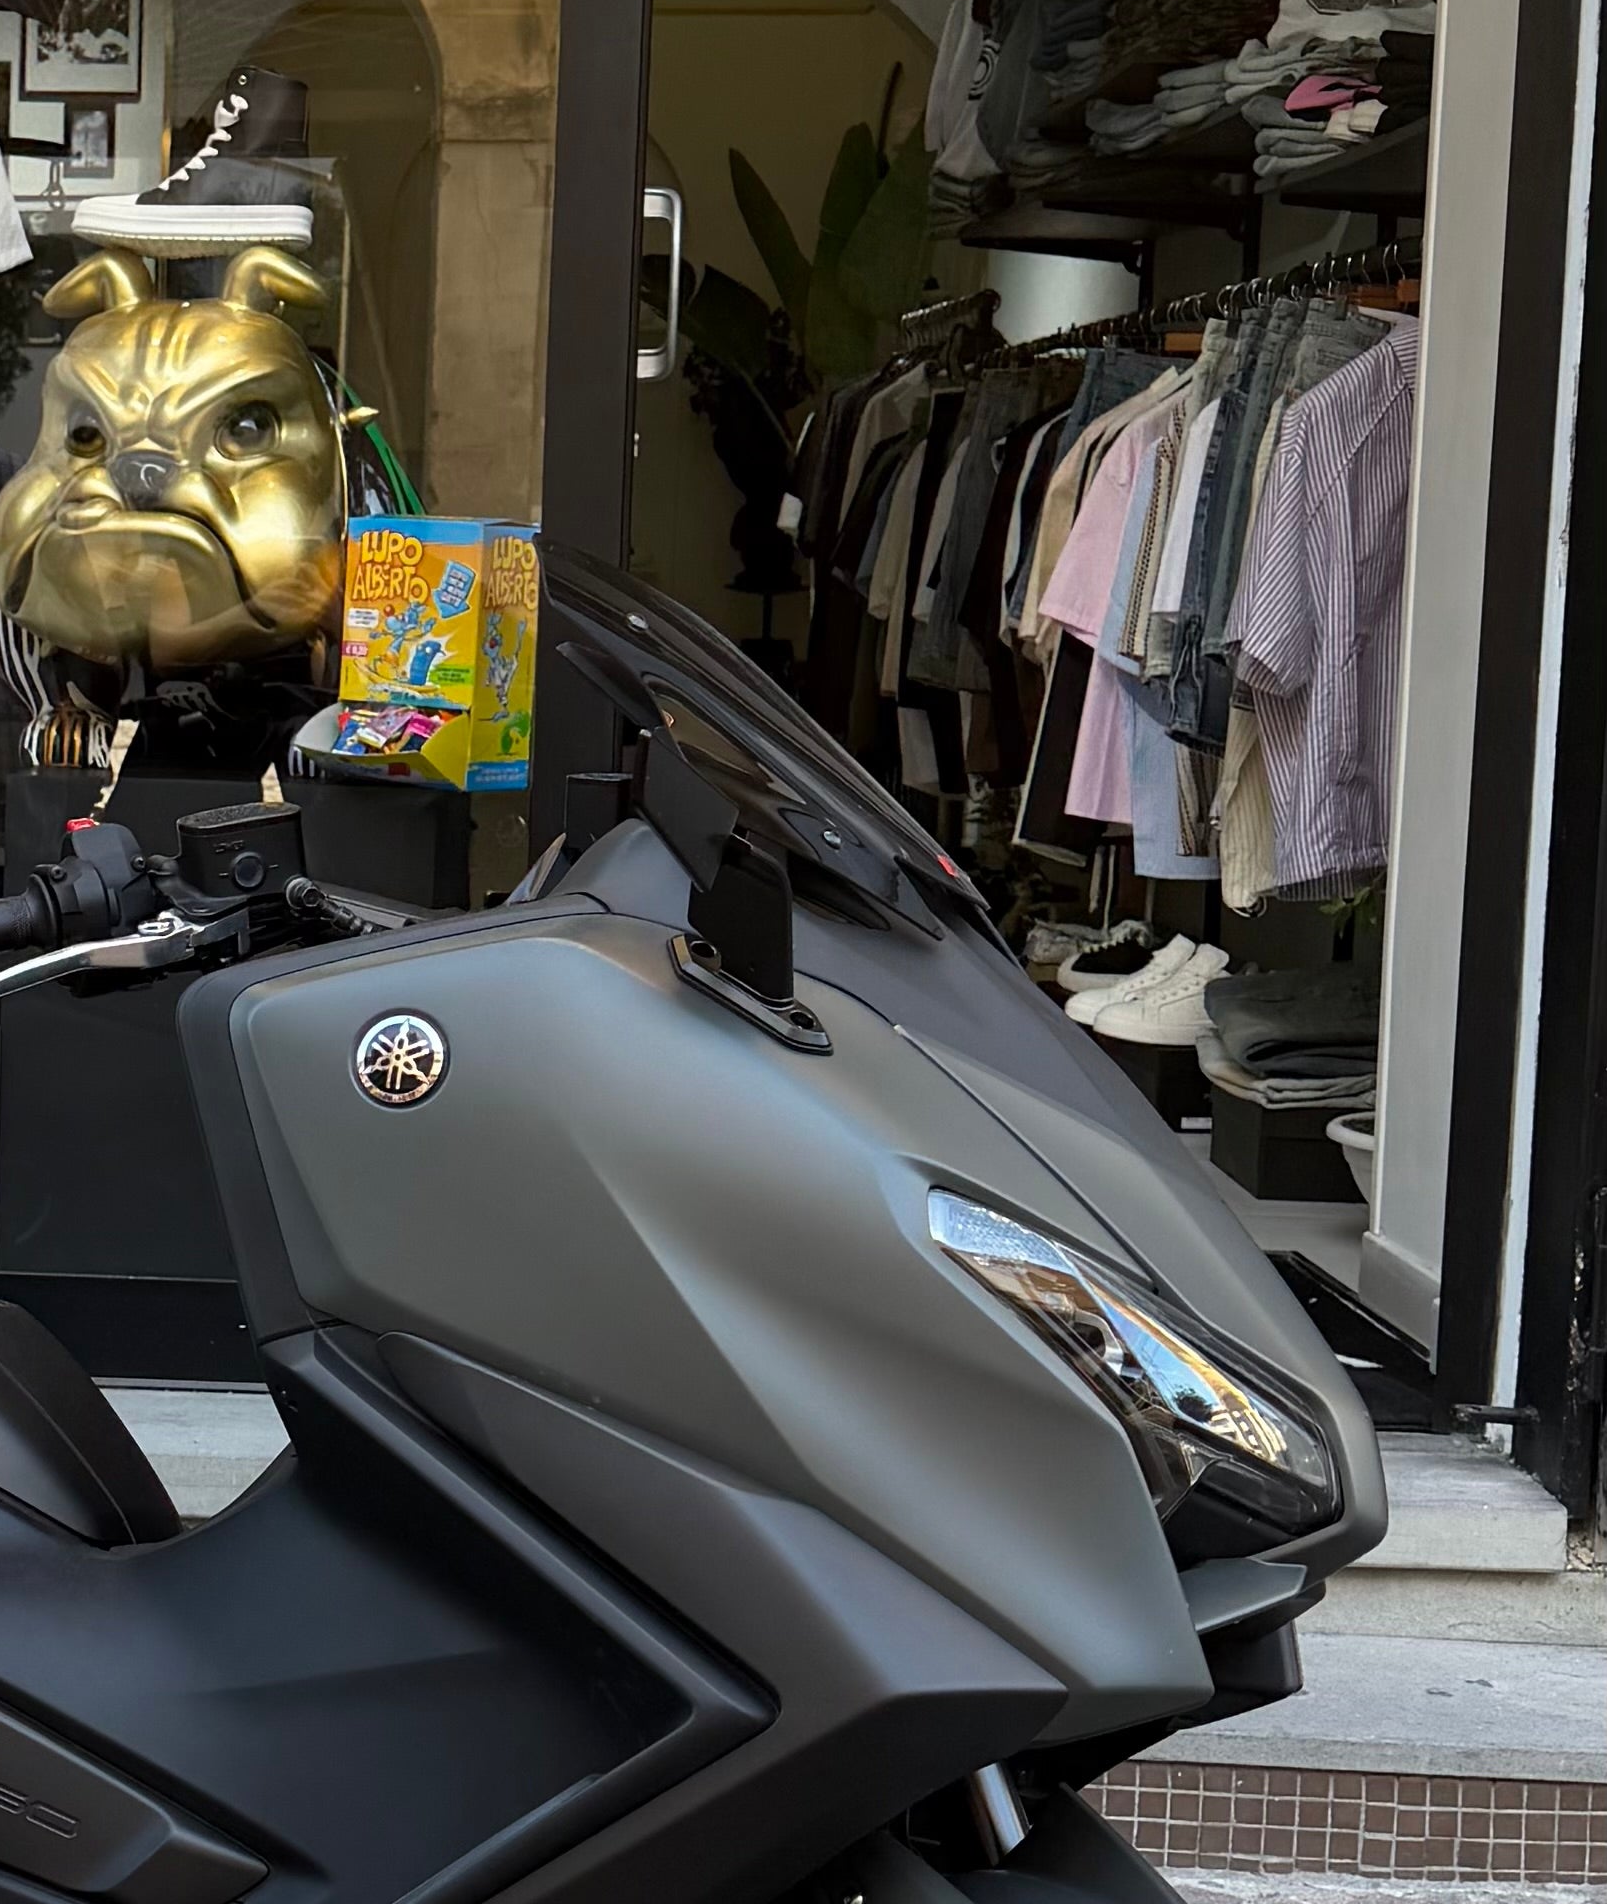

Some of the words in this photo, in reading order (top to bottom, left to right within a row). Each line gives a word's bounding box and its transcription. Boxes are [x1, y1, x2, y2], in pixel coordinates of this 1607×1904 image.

[360, 529, 424, 566] LUPO
[492, 535, 537, 570] LUPO
[351, 562, 430, 605] ALBERTO
[483, 569, 539, 611] ALBERTO
